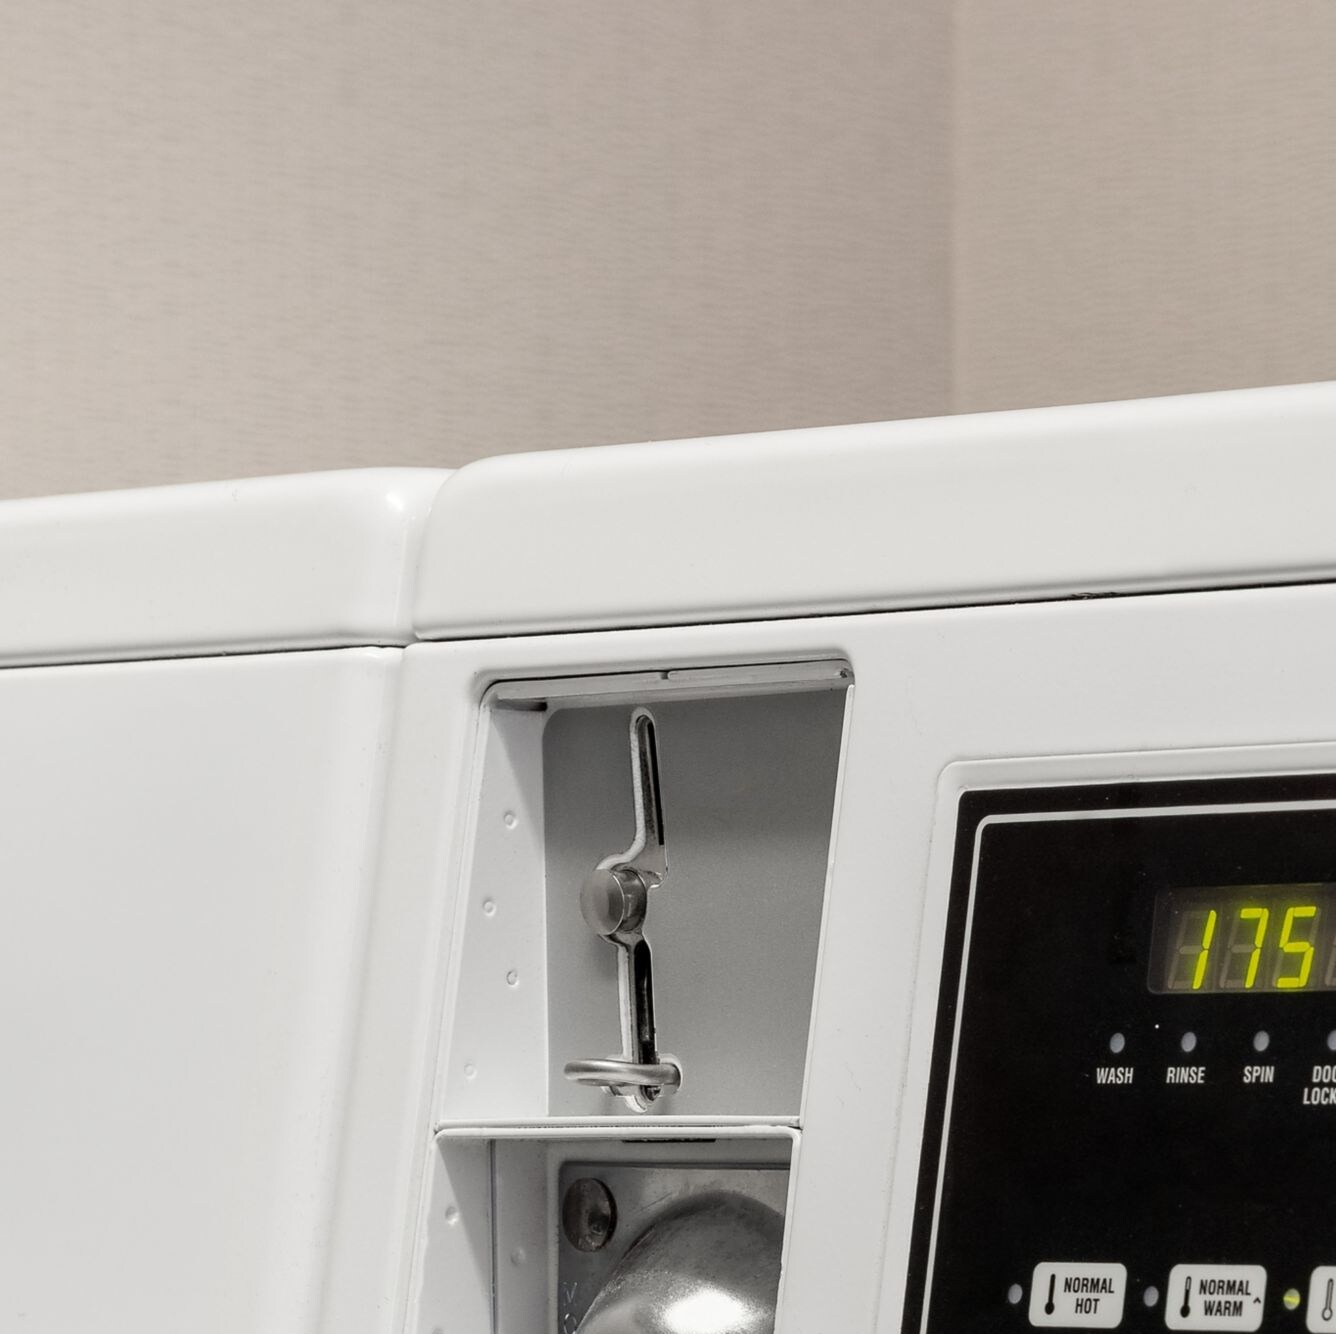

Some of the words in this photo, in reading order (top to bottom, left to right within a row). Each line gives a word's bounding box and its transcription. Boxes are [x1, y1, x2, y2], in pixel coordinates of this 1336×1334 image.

[1193, 906, 1316, 989] 175
[1097, 1067, 1133, 1084] WASH
[1166, 1067, 1205, 1083] RINSE
[1243, 1066, 1274, 1083] SPIN
[1064, 1277, 1114, 1293] NORMAL
[1199, 1279, 1251, 1296] NORMAL
[1075, 1298, 1100, 1314] HOT
[1204, 1300, 1243, 1316] WARM
